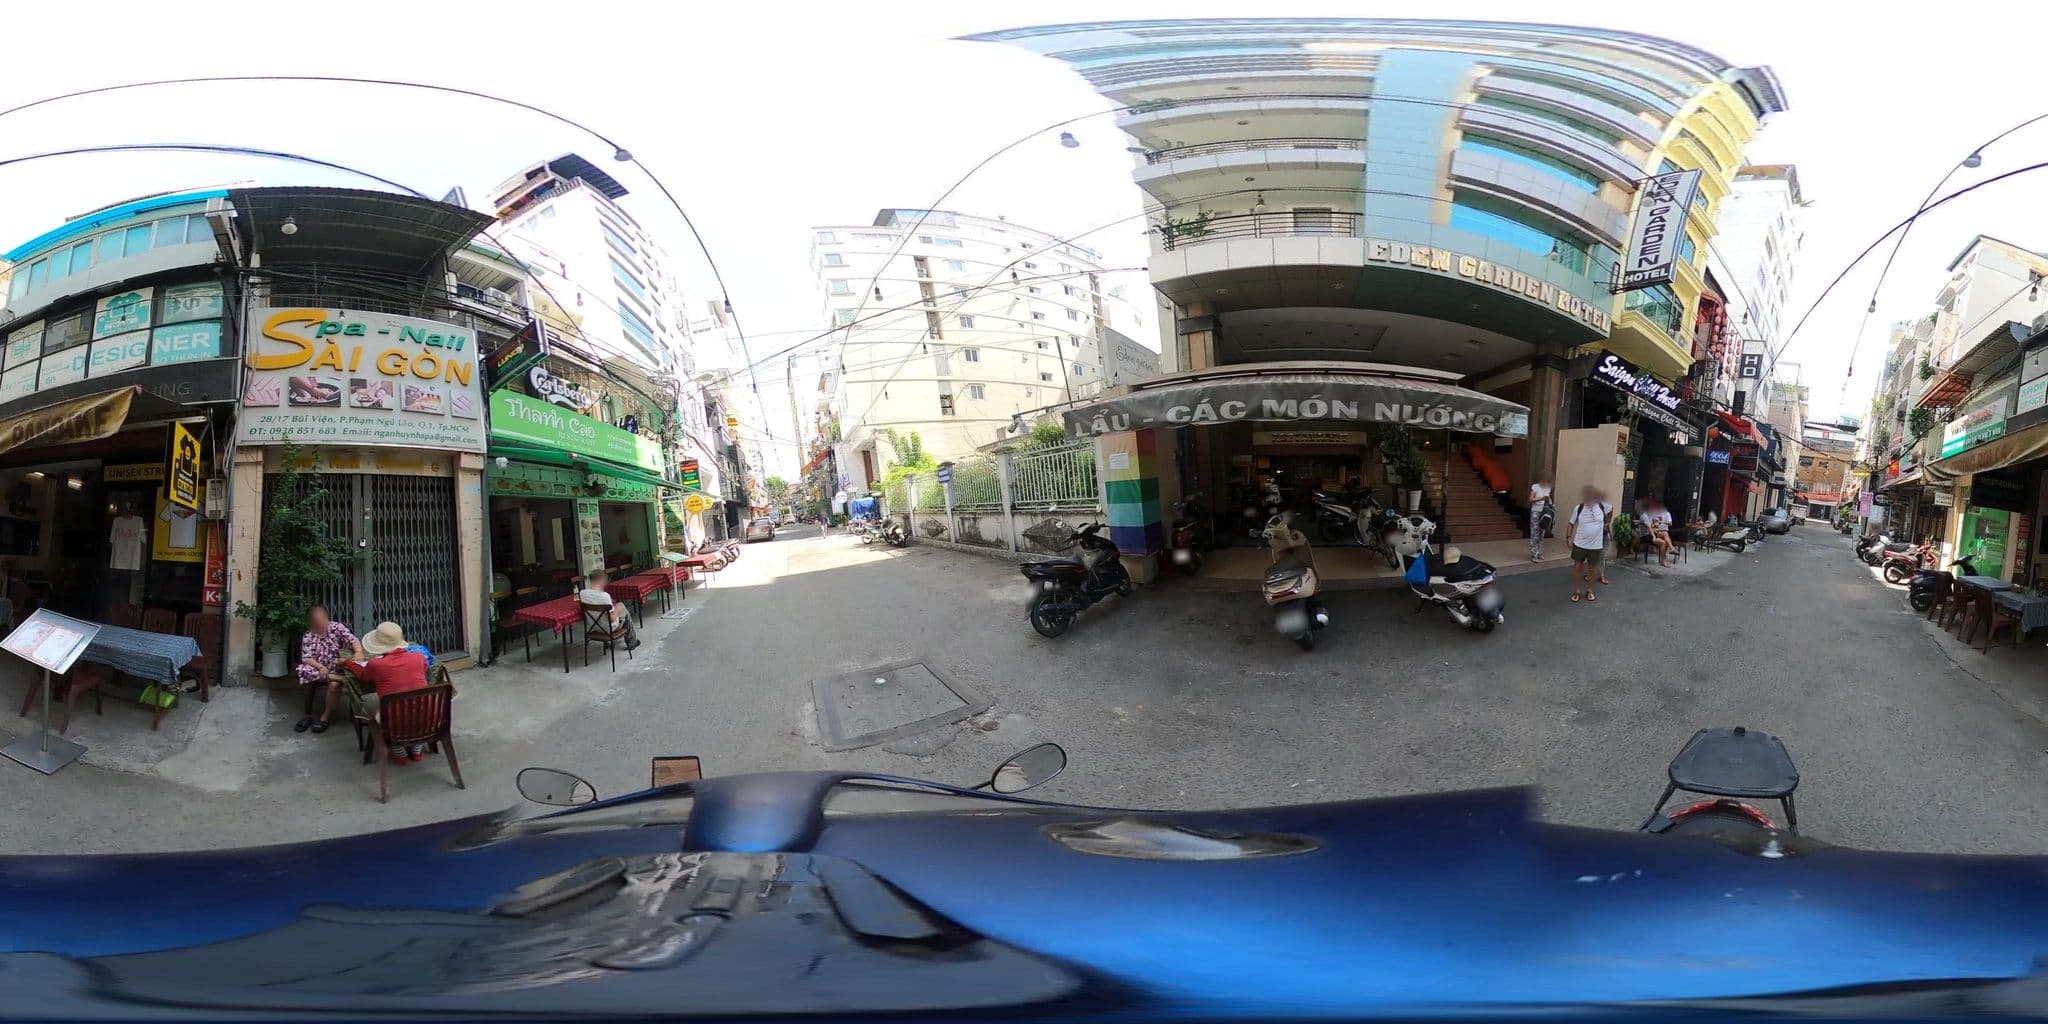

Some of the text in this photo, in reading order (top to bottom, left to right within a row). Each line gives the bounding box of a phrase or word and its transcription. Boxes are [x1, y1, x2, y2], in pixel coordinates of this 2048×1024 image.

[1638, 206, 1672, 268] GARDEN
[1367, 241, 1612, 333] EDEN GARDEN HOTEL
[1624, 268, 1669, 284] HOTEL
[399, 325, 466, 351] Nail
[377, 348, 472, 386] GÒN
[1598, 355, 1637, 386] Saigon
[1656, 386, 1682, 410] Hostel
[530, 366, 591, 408] Carlsberg
[259, 415, 289, 424] 28/17
[311, 415, 336, 425] Viện,
[339, 416, 374, 426] P.Phạm
[438, 423, 469, 433] Tp.HCM
[504, 398, 564, 430] Thanh
[568, 418, 595, 439] Cao
[1074, 408, 1130, 437] LẨU
[1166, 398, 1247, 423] CÁC
[1261, 394, 1358, 419] MÓN
[1374, 402, 1495, 431] NƯỚNG
[1638, 402, 1660, 419] Saigon
[249, 427, 267, 435] ĐT:
[296, 427, 314, 435] 851
[318, 427, 337, 435] 683
[343, 428, 372, 436] Email:
[374, 429, 478, 444] nganhuynhspa@gmail.com
[109, 466, 165, 478] UNISEX STR
